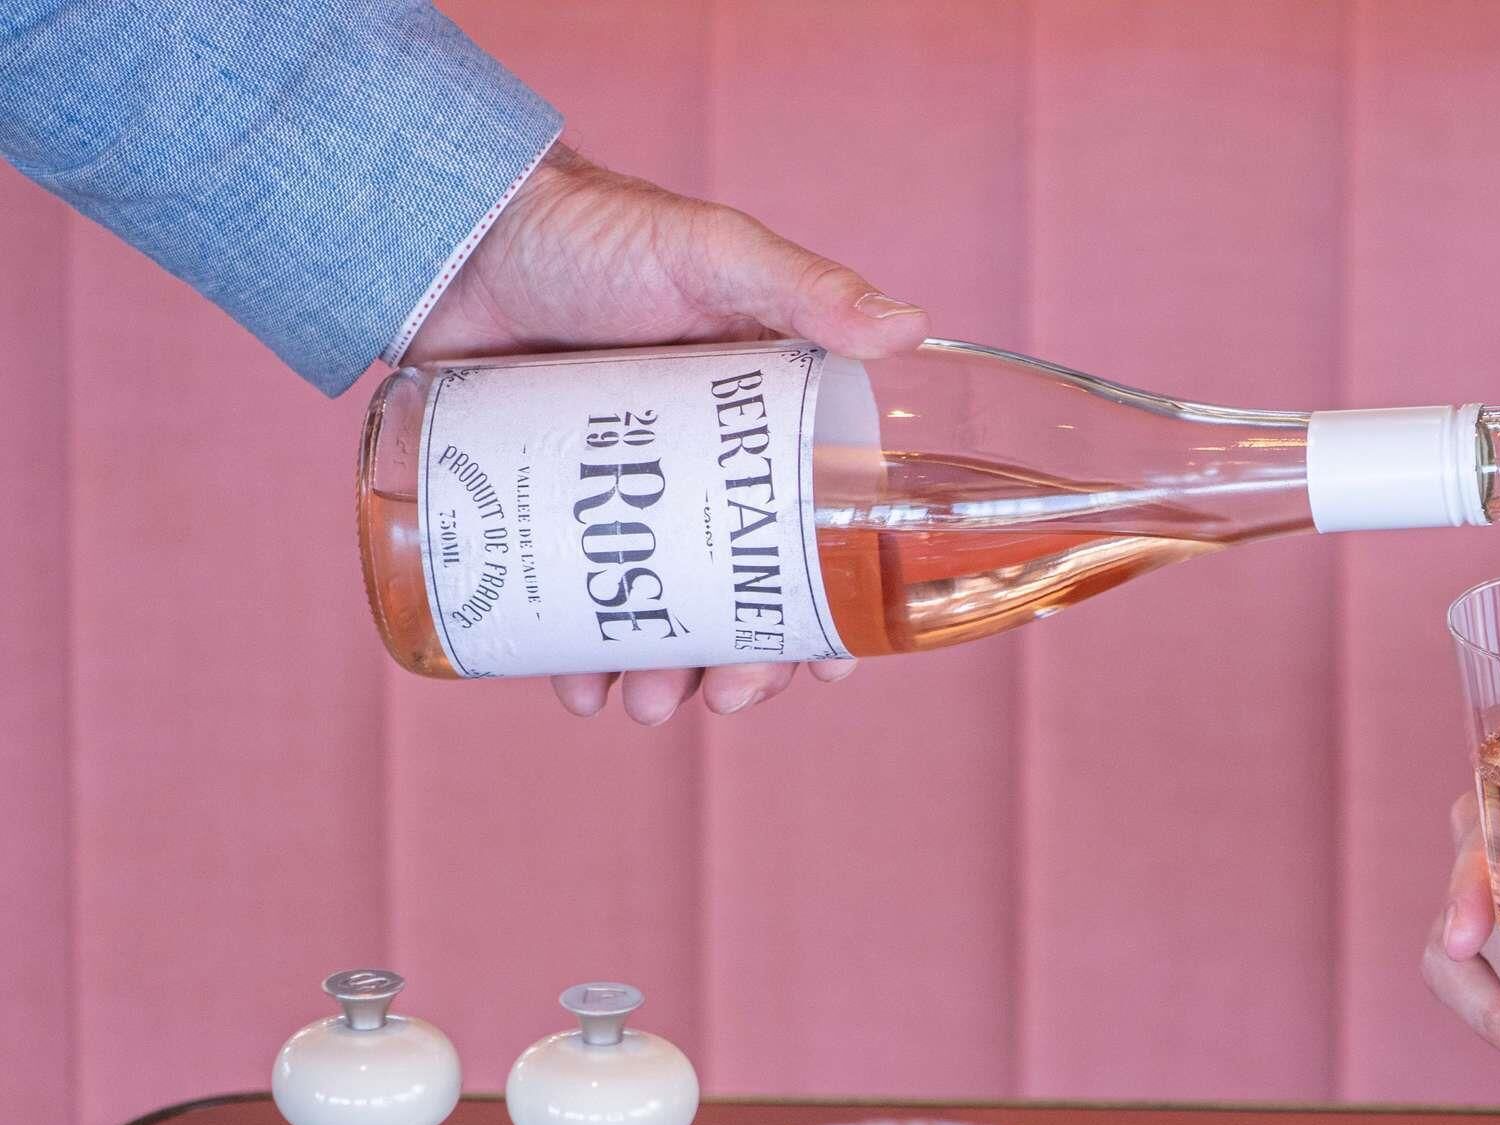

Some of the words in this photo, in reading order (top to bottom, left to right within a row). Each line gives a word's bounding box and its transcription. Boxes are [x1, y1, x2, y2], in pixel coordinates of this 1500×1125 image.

[586, 413, 621, 448] 19
[622, 409, 658, 446] 20
[439, 445, 504, 519] PRODUIT
[516, 465, 531, 523] VALLEE
[711, 369, 785, 626] BERTAINE
[439, 509, 461, 568] 750ML
[483, 527, 509, 554] DE
[518, 527, 533, 550] DE
[573, 456, 691, 642] ROSÉ
[451, 562, 508, 629] FRANCE
[734, 629, 753, 651] FILS
[754, 630, 785, 655] ET
